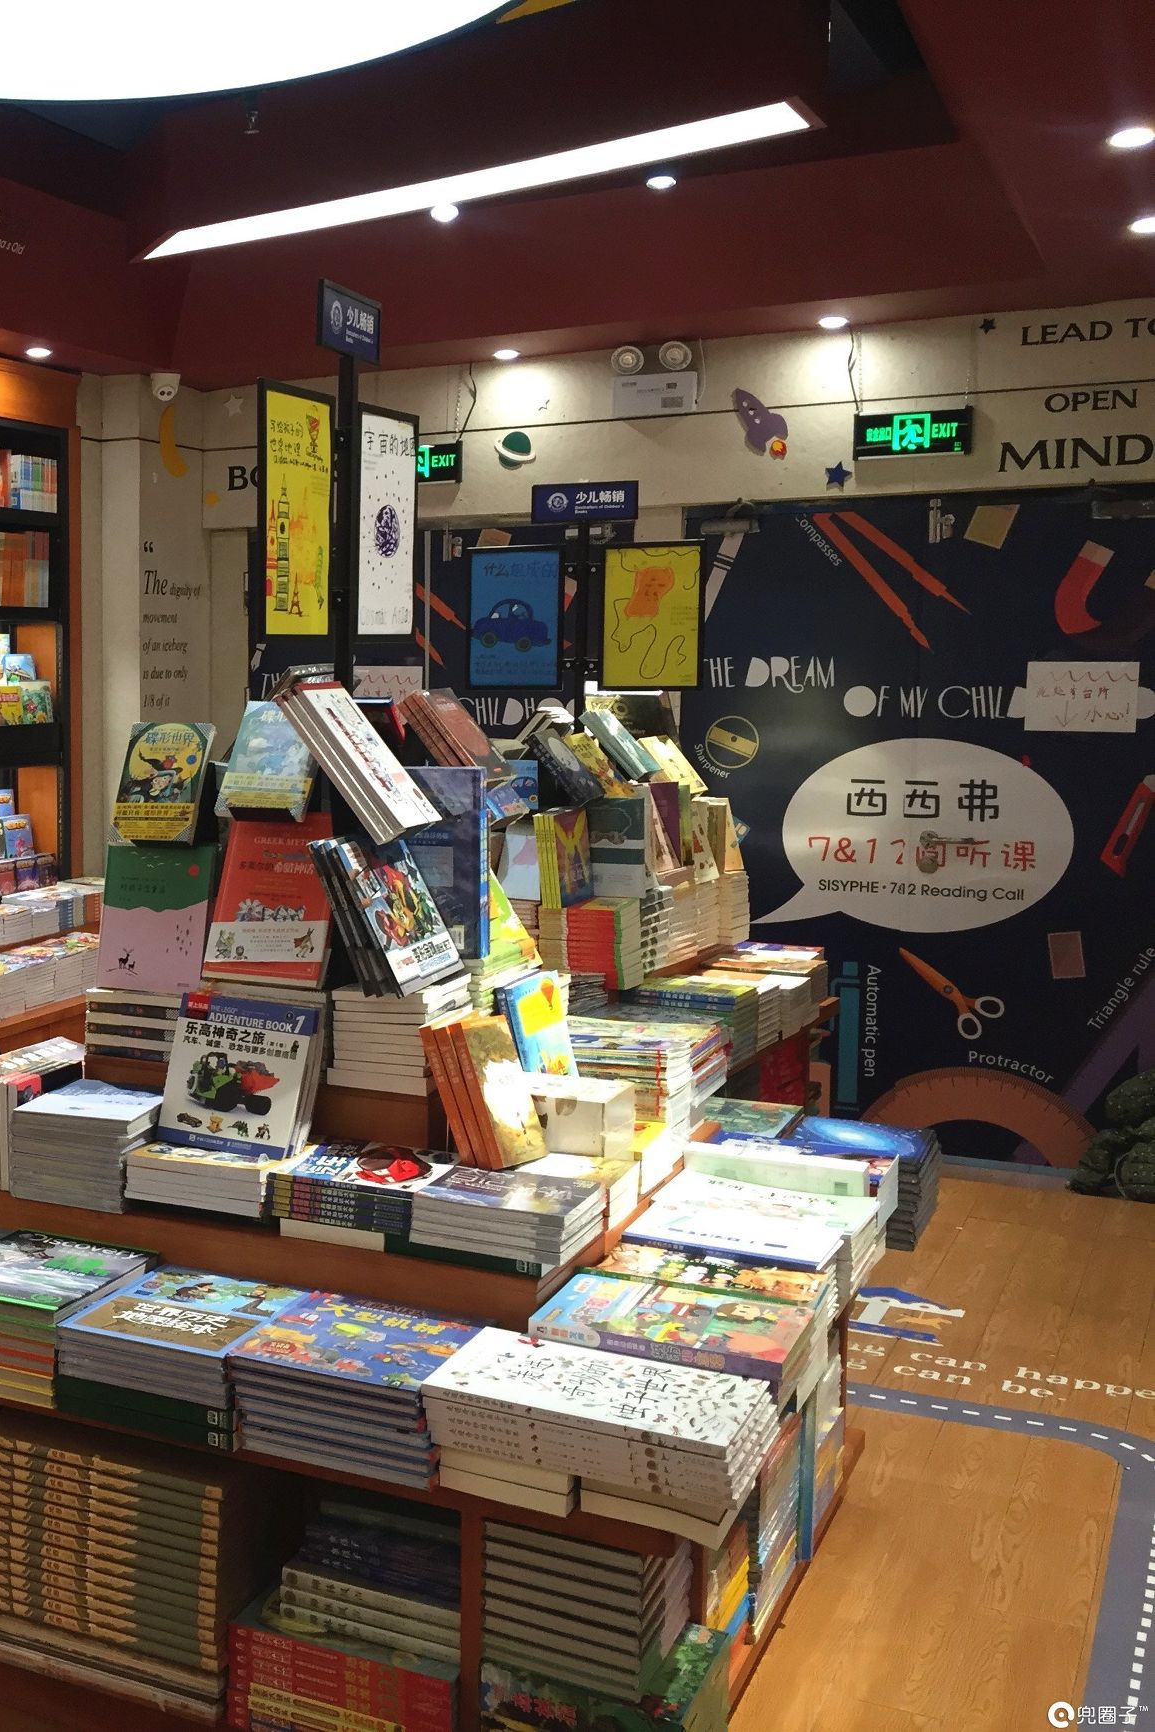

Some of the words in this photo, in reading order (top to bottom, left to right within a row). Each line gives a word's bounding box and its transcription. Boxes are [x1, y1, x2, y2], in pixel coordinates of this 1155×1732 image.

[347, 305, 374, 335] 少儿畅销
[1020, 320, 1113, 346] LEAD
[1044, 388, 1138, 413] OPEN
[931, 422, 958, 438] EXIT
[431, 454, 457, 468] EXIT
[998, 434, 1155, 473] MIND
[575, 490, 625, 504] 少儿畅销
[144, 570, 168, 596] The
[170, 584, 193, 600] dignity
[143, 612, 178, 624] movement
[143, 638, 151, 653] of
[162, 638, 188, 654] iceberg
[150, 668, 163, 680] due
[746, 656, 835, 693] DREAM
[844, 685, 889, 718] OF
[900, 686, 928, 718] MY
[145, 731, 198, 746] 碟形世界
[694, 743, 731, 780] Sharpener
[847, 779, 999, 822] 西西弗
[818, 879, 879, 893] SISYPHE
[921, 884, 988, 901] Reading
[992, 887, 1025, 901] Call
[867, 964, 881, 1044] Automatic
[1087, 976, 1135, 1030] Triangle
[185, 1021, 266, 1045] 乐高神奇之旅
[208, 1012, 265, 1029] ADVENTURE
[266, 1020, 292, 1033] BOOK
[293, 1015, 306, 1034] 1
[863, 1048, 876, 1077] pen
[968, 1051, 1055, 1084] Protractor
[30, 1233, 144, 1260] Discovery
[134, 1302, 231, 1329] 世界历史
[315, 1303, 446, 1335] 大型机械
[893, 1365, 972, 1386] can
[910, 1353, 987, 1372] can
[611, 1366, 681, 1419] 虫子世界
